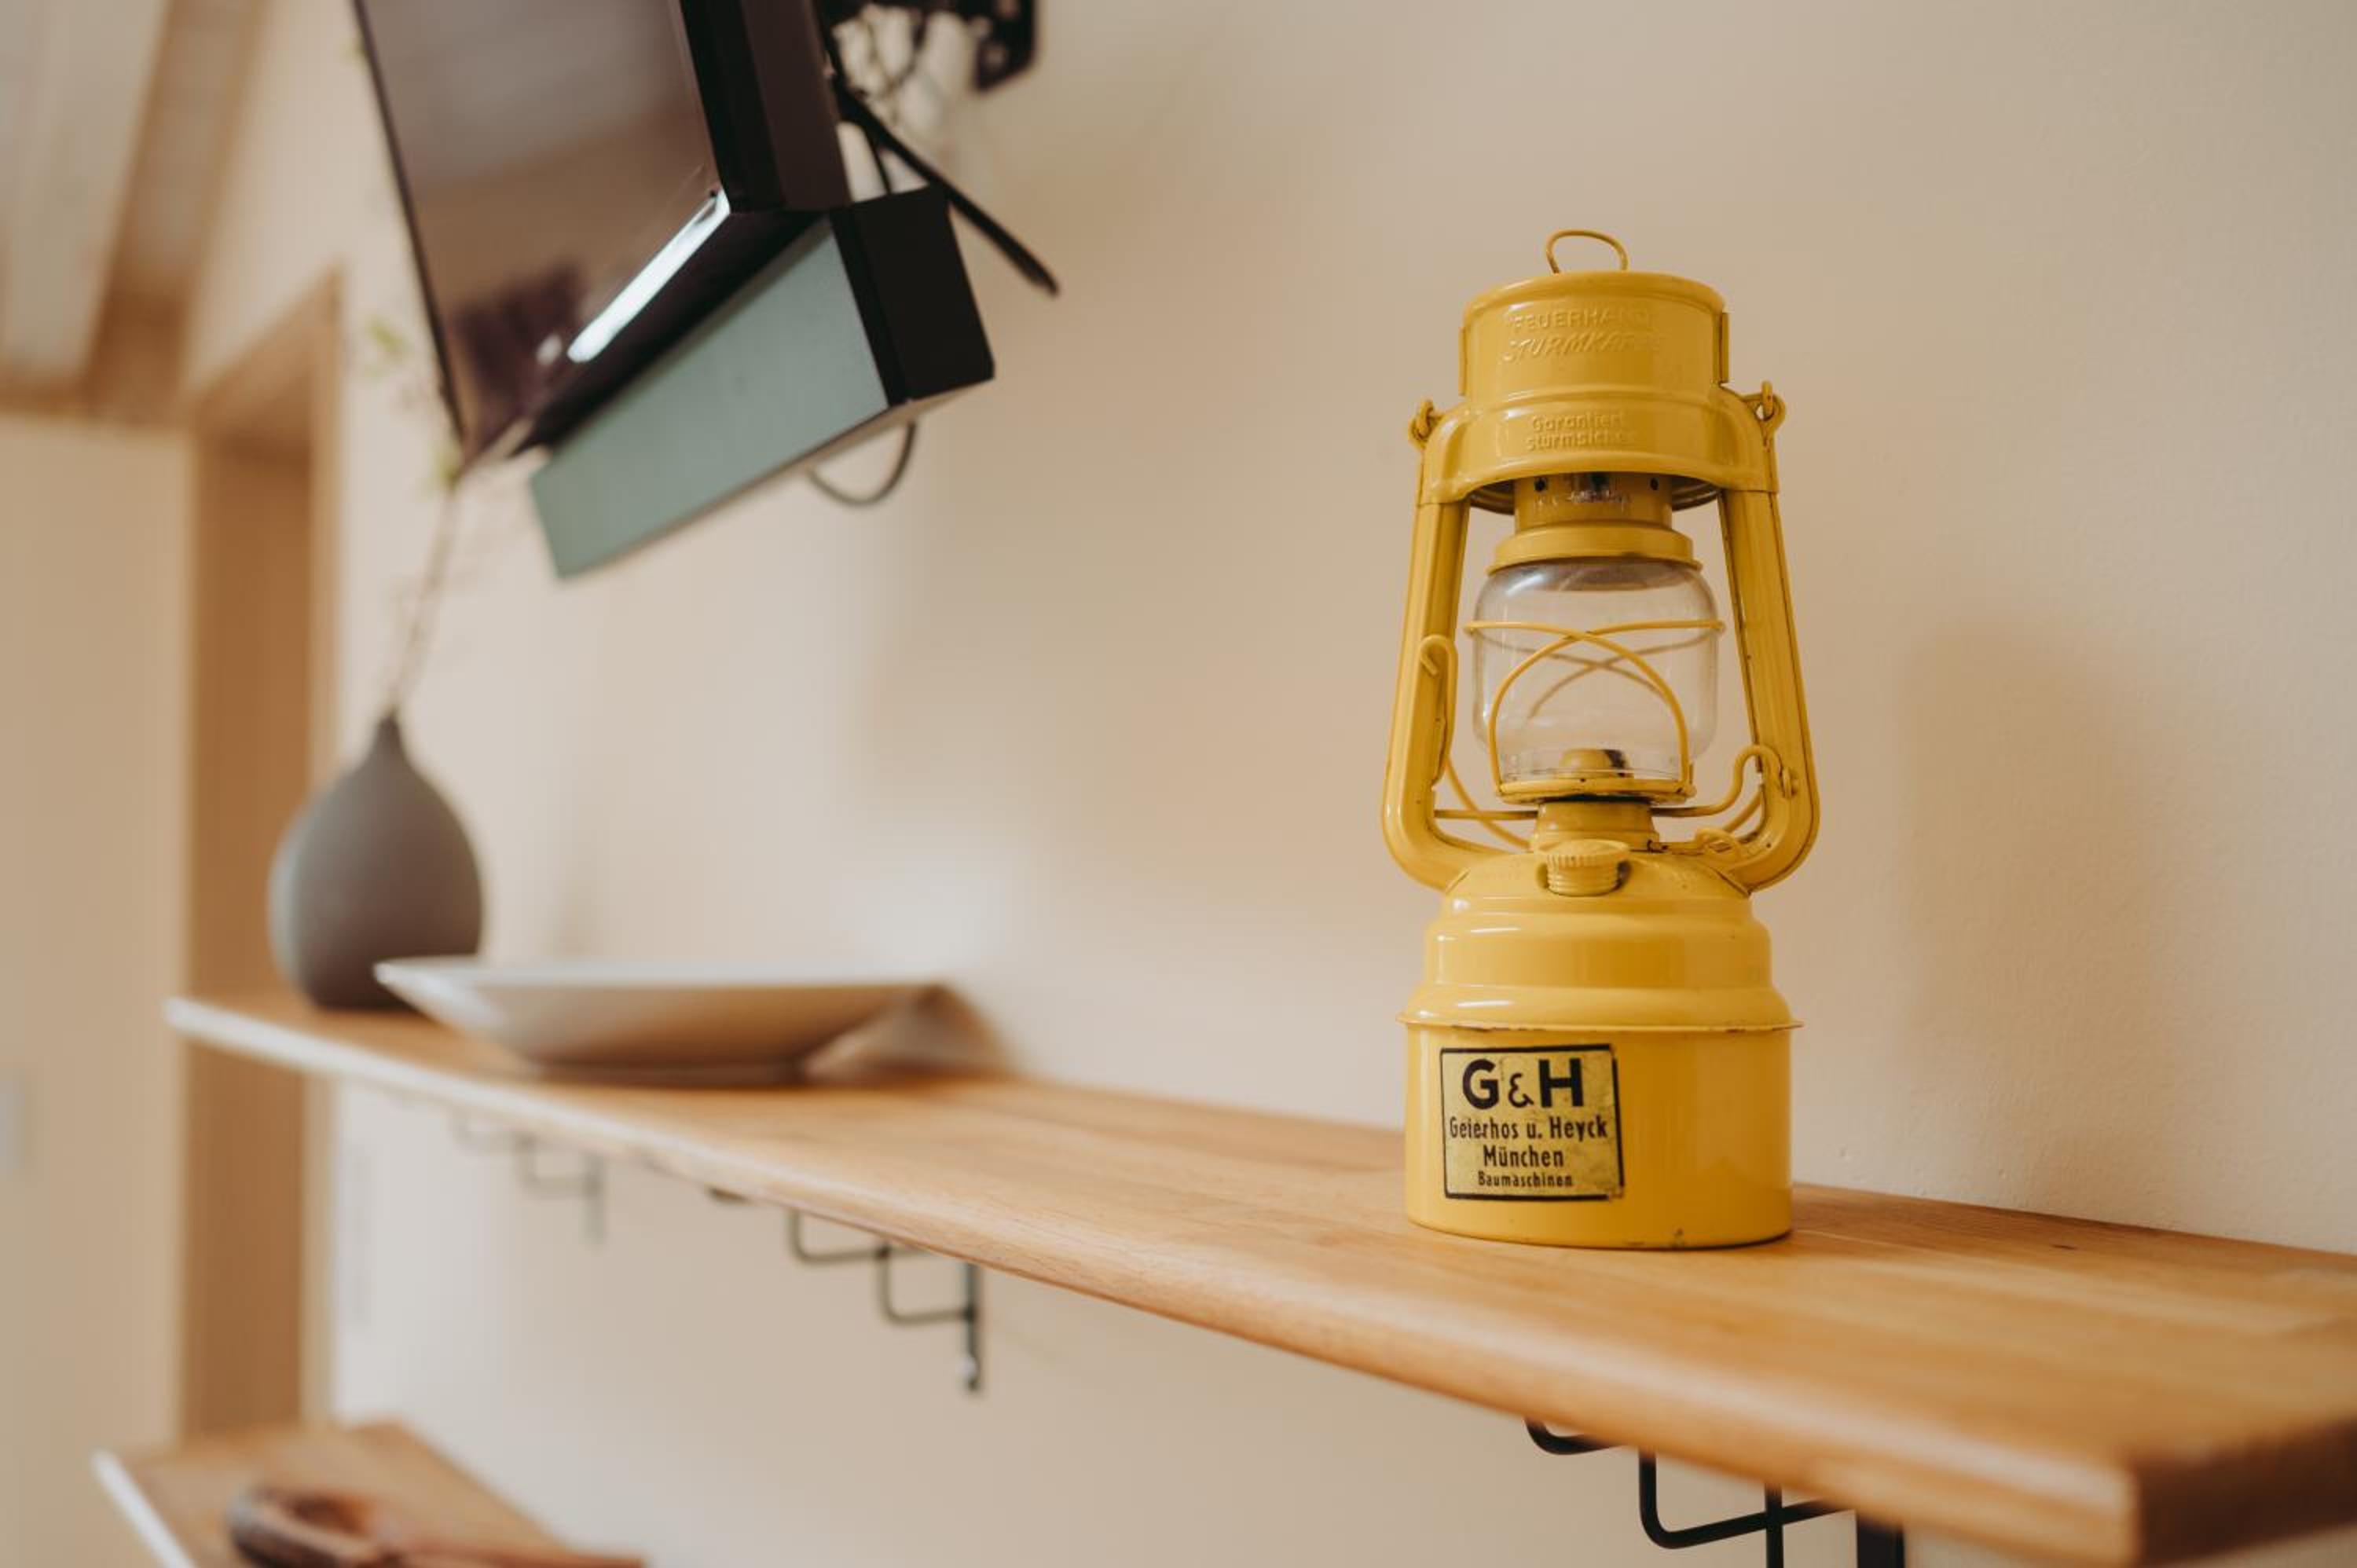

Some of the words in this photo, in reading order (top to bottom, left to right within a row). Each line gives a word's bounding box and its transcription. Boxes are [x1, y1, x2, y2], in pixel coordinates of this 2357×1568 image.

[1450, 1116, 1519, 1138] Geierhos
[1527, 1123, 1542, 1138] u.
[1549, 1114, 1607, 1141] Heyck
[1483, 1145, 1564, 1167] München
[1478, 1171, 1573, 1187] Baumaschinen
